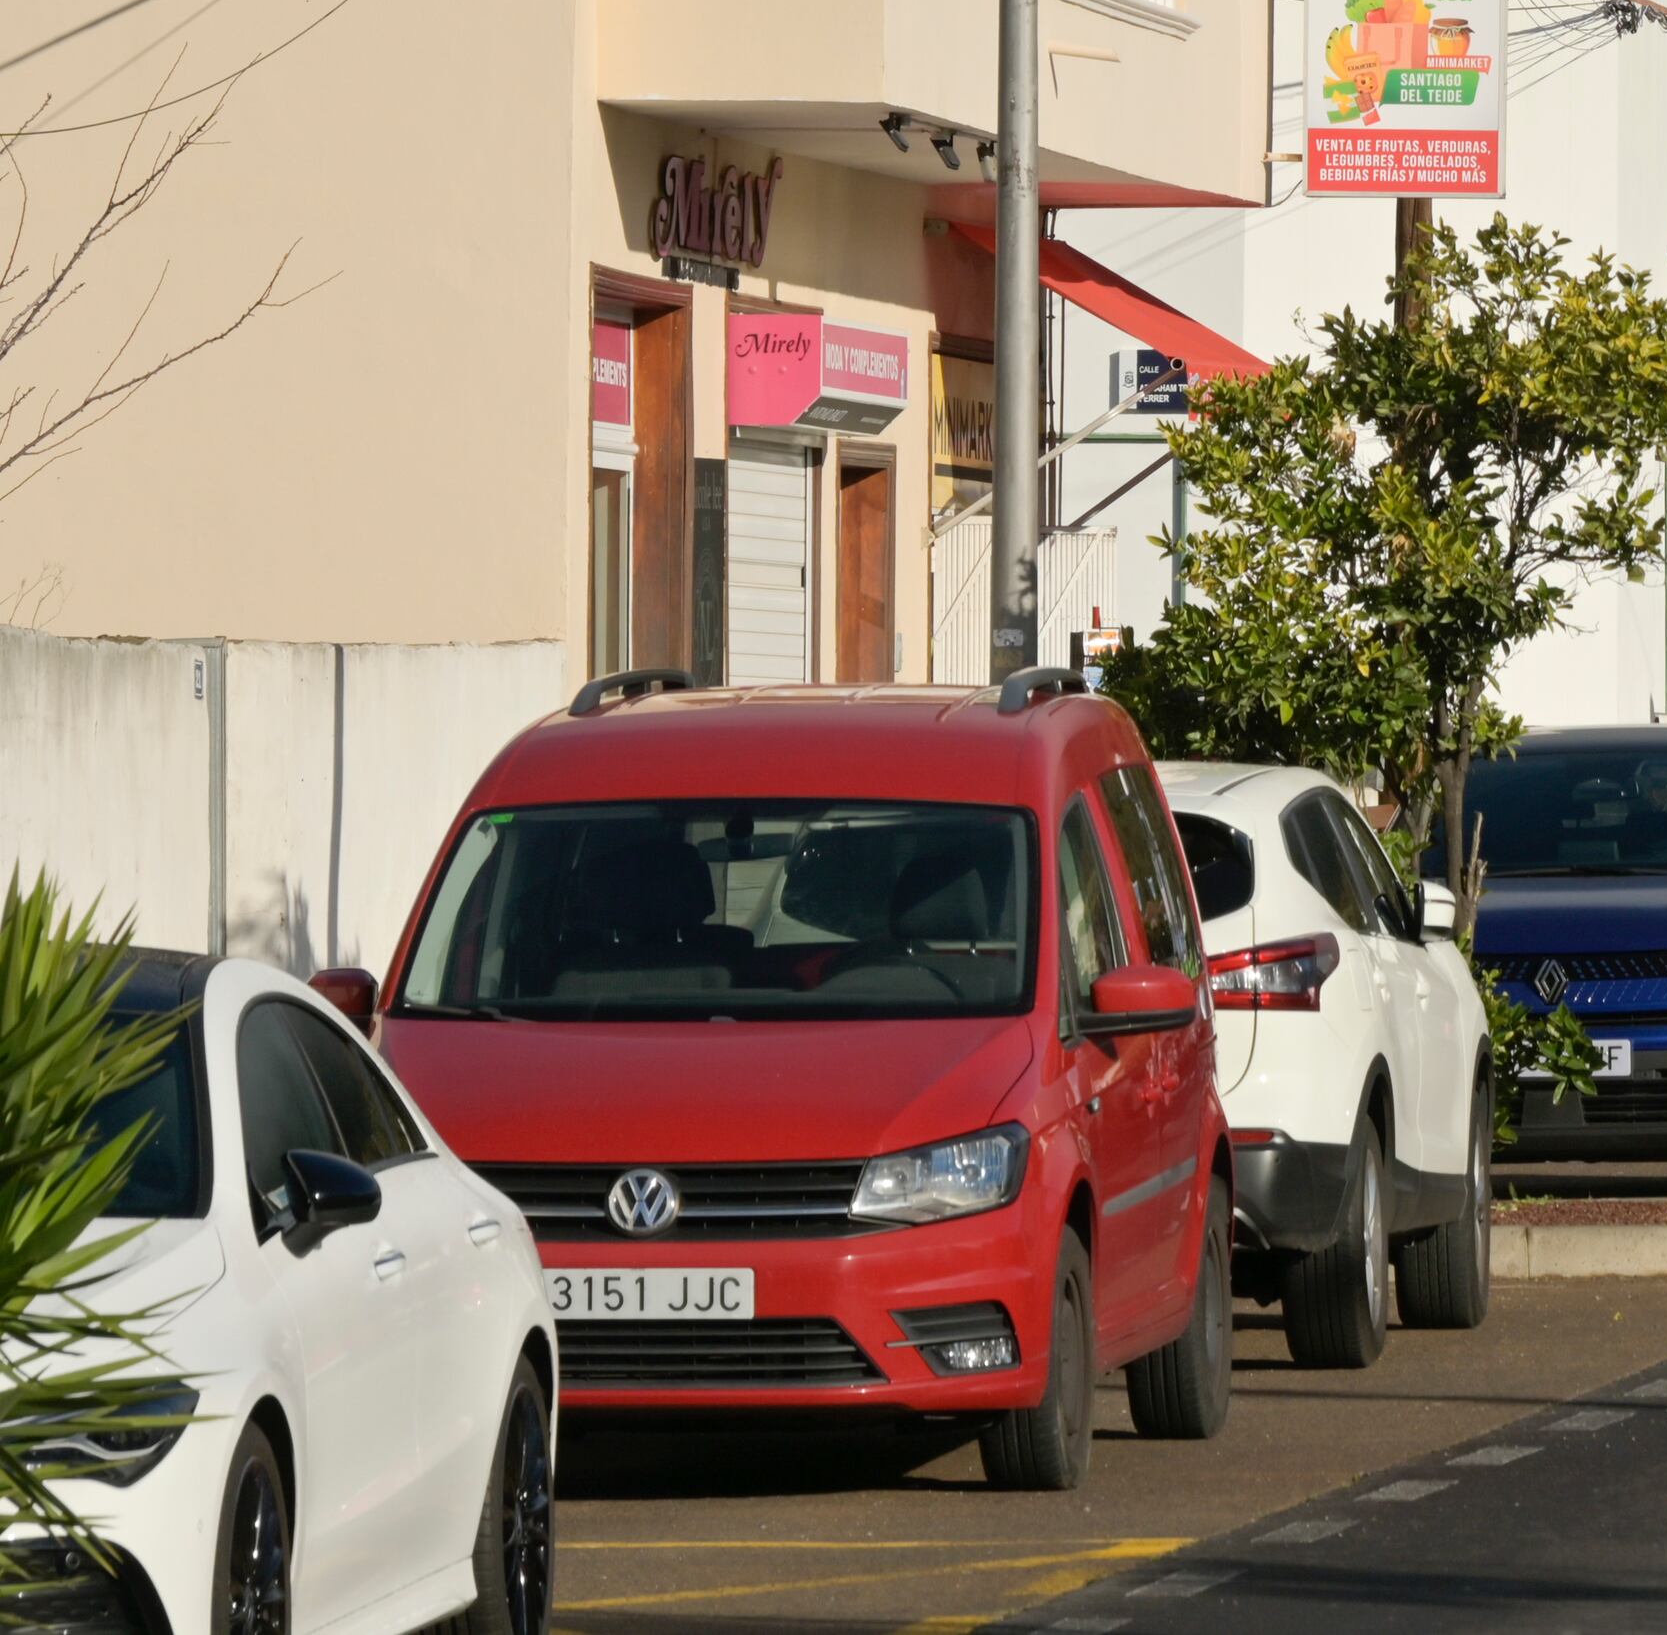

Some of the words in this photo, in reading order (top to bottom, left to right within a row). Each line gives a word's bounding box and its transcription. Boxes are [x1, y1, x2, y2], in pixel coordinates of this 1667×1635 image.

[1426, 57, 1489, 69] MINIMARKET
[1400, 73, 1461, 87] SANTIAGO
[1400, 89, 1423, 103] DEL
[1427, 89, 1462, 103] TEIDE
[1316, 139, 1352, 152] VENTA
[1357, 139, 1371, 152] DE
[1375, 139, 1424, 154] FRUTAS,
[1427, 140, 1491, 155] VERDURAS,
[1325, 154, 1398, 169] LEGUMBRES,
[1402, 155, 1481, 170] CONGELADOS,
[1319, 168, 1369, 182] BEBIDAS
[1373, 166, 1406, 182] FRÍAS
[1417, 170, 1458, 183] MUCHO
[1461, 168, 1487, 183] MÁS
[735, 332, 811, 361] Mirely
[825, 342, 842, 371] MODA
[843, 346, 851, 372] Y
[850, 348, 899, 381] COMPLEMENTOS
[1139, 365, 1159, 374] CALLE
[1139, 384, 1177, 393] AAHAM
[1140, 394, 1170, 403] ERRER
[552, 1276, 645, 1312] 3151
[668, 1276, 741, 1312] JJC
